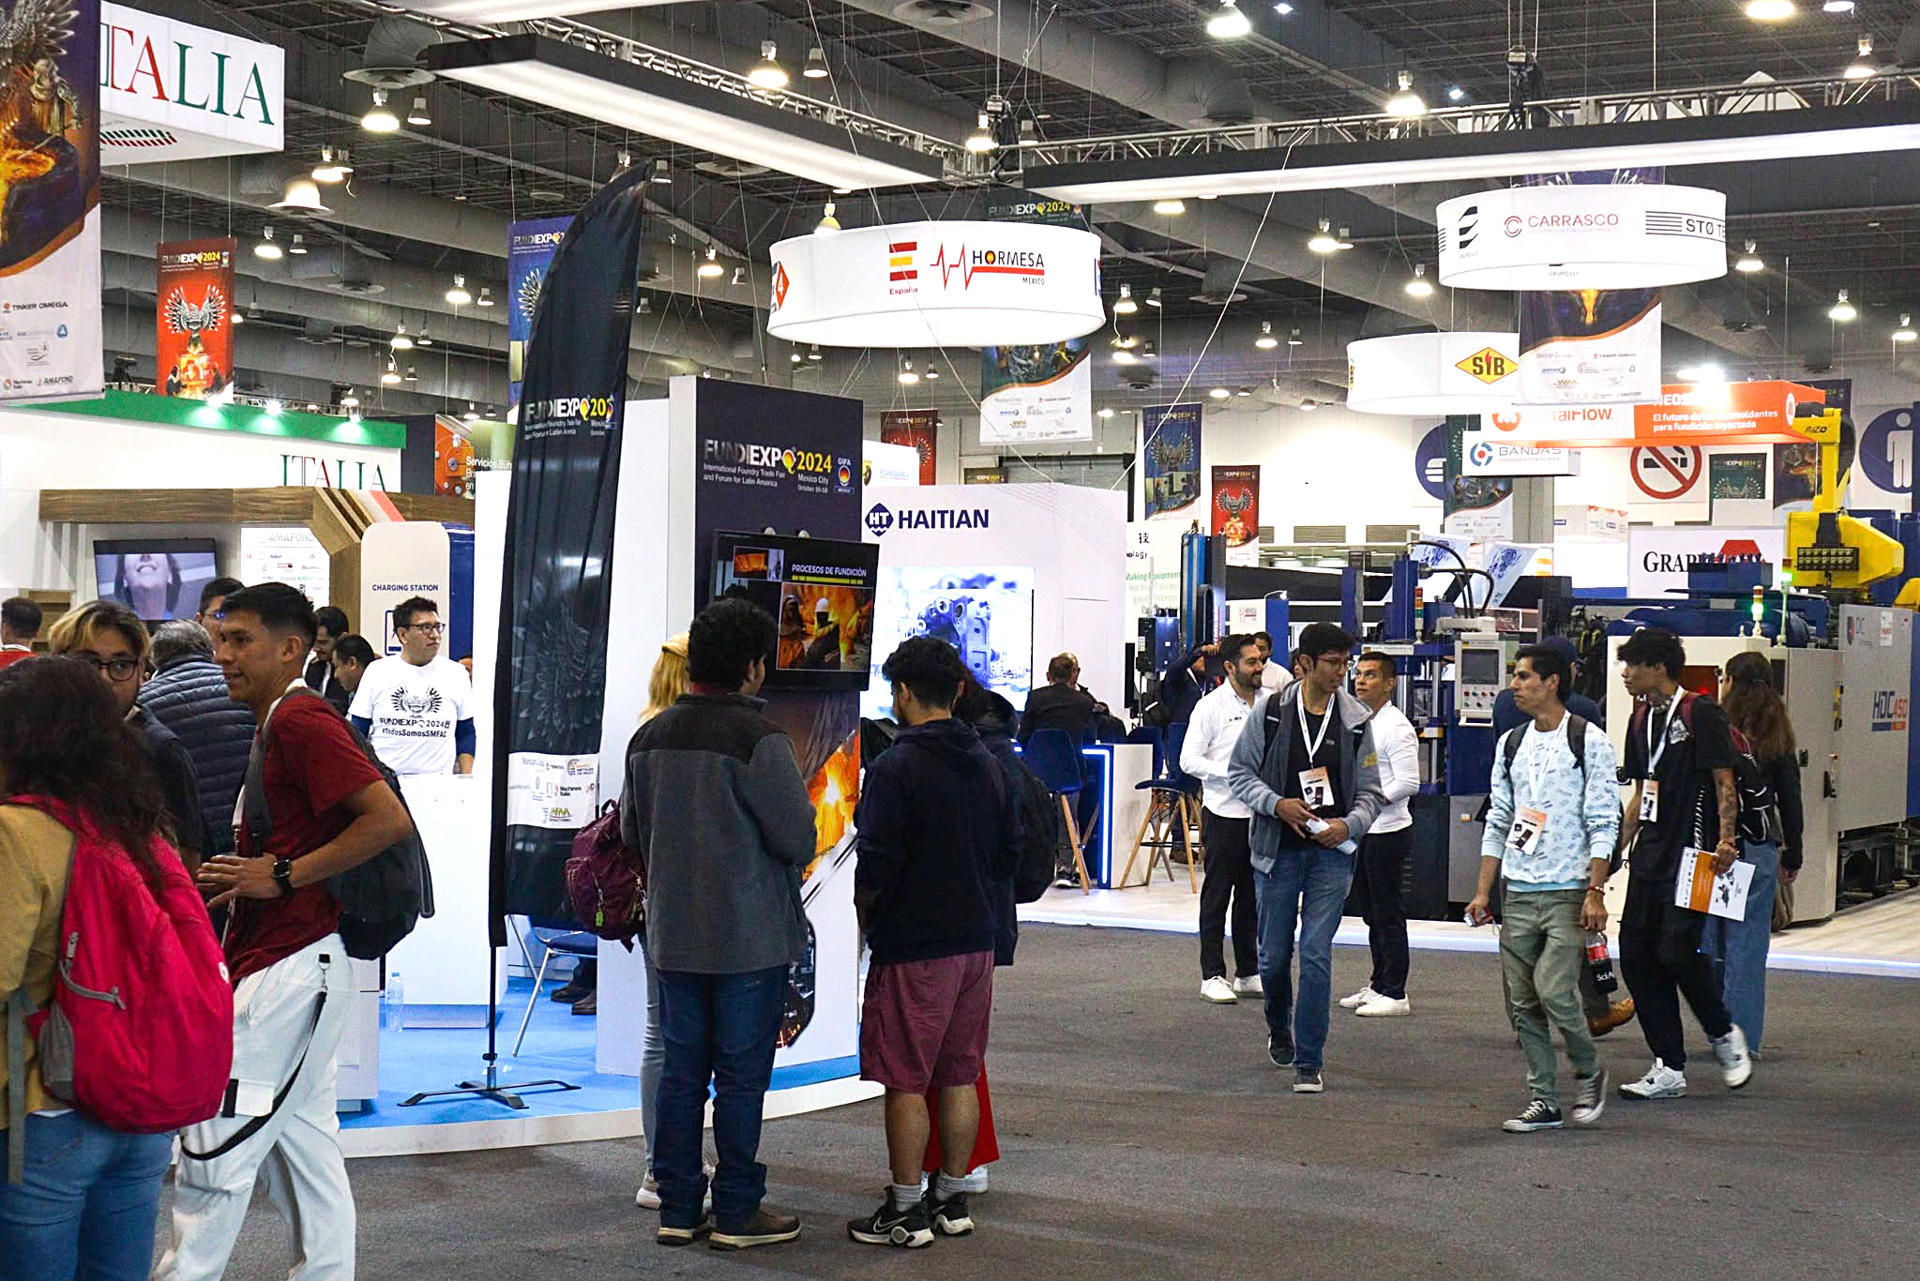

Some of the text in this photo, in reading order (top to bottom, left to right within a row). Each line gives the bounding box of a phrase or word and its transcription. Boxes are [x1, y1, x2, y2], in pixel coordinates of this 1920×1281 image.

[100, 22, 275, 126] TALIA
[1044, 201, 1071, 213] 2024
[1528, 213, 1619, 228] CARRASCO
[203, 251, 220, 262] 2024
[973, 250, 1045, 267] HORMESA
[889, 288, 919, 296] España
[12, 301, 69, 311] TINKER OMEGA
[1662, 413, 1689, 422] futuro
[1653, 424, 1673, 433] para
[466, 455, 498, 467] Servicios
[796, 450, 832, 474] 2024
[703, 462, 786, 479] International Foundry Trade Fair
[703, 473, 778, 488] and Forum for Latin America
[798, 474, 829, 486] Mexico City
[868, 509, 990, 529] HT HAITIAN
[791, 563, 868, 577] PROCESOS DE FUNDICIÓN
[372, 583, 439, 592] CHARGING STATION
[426, 720, 445, 728] 2024
